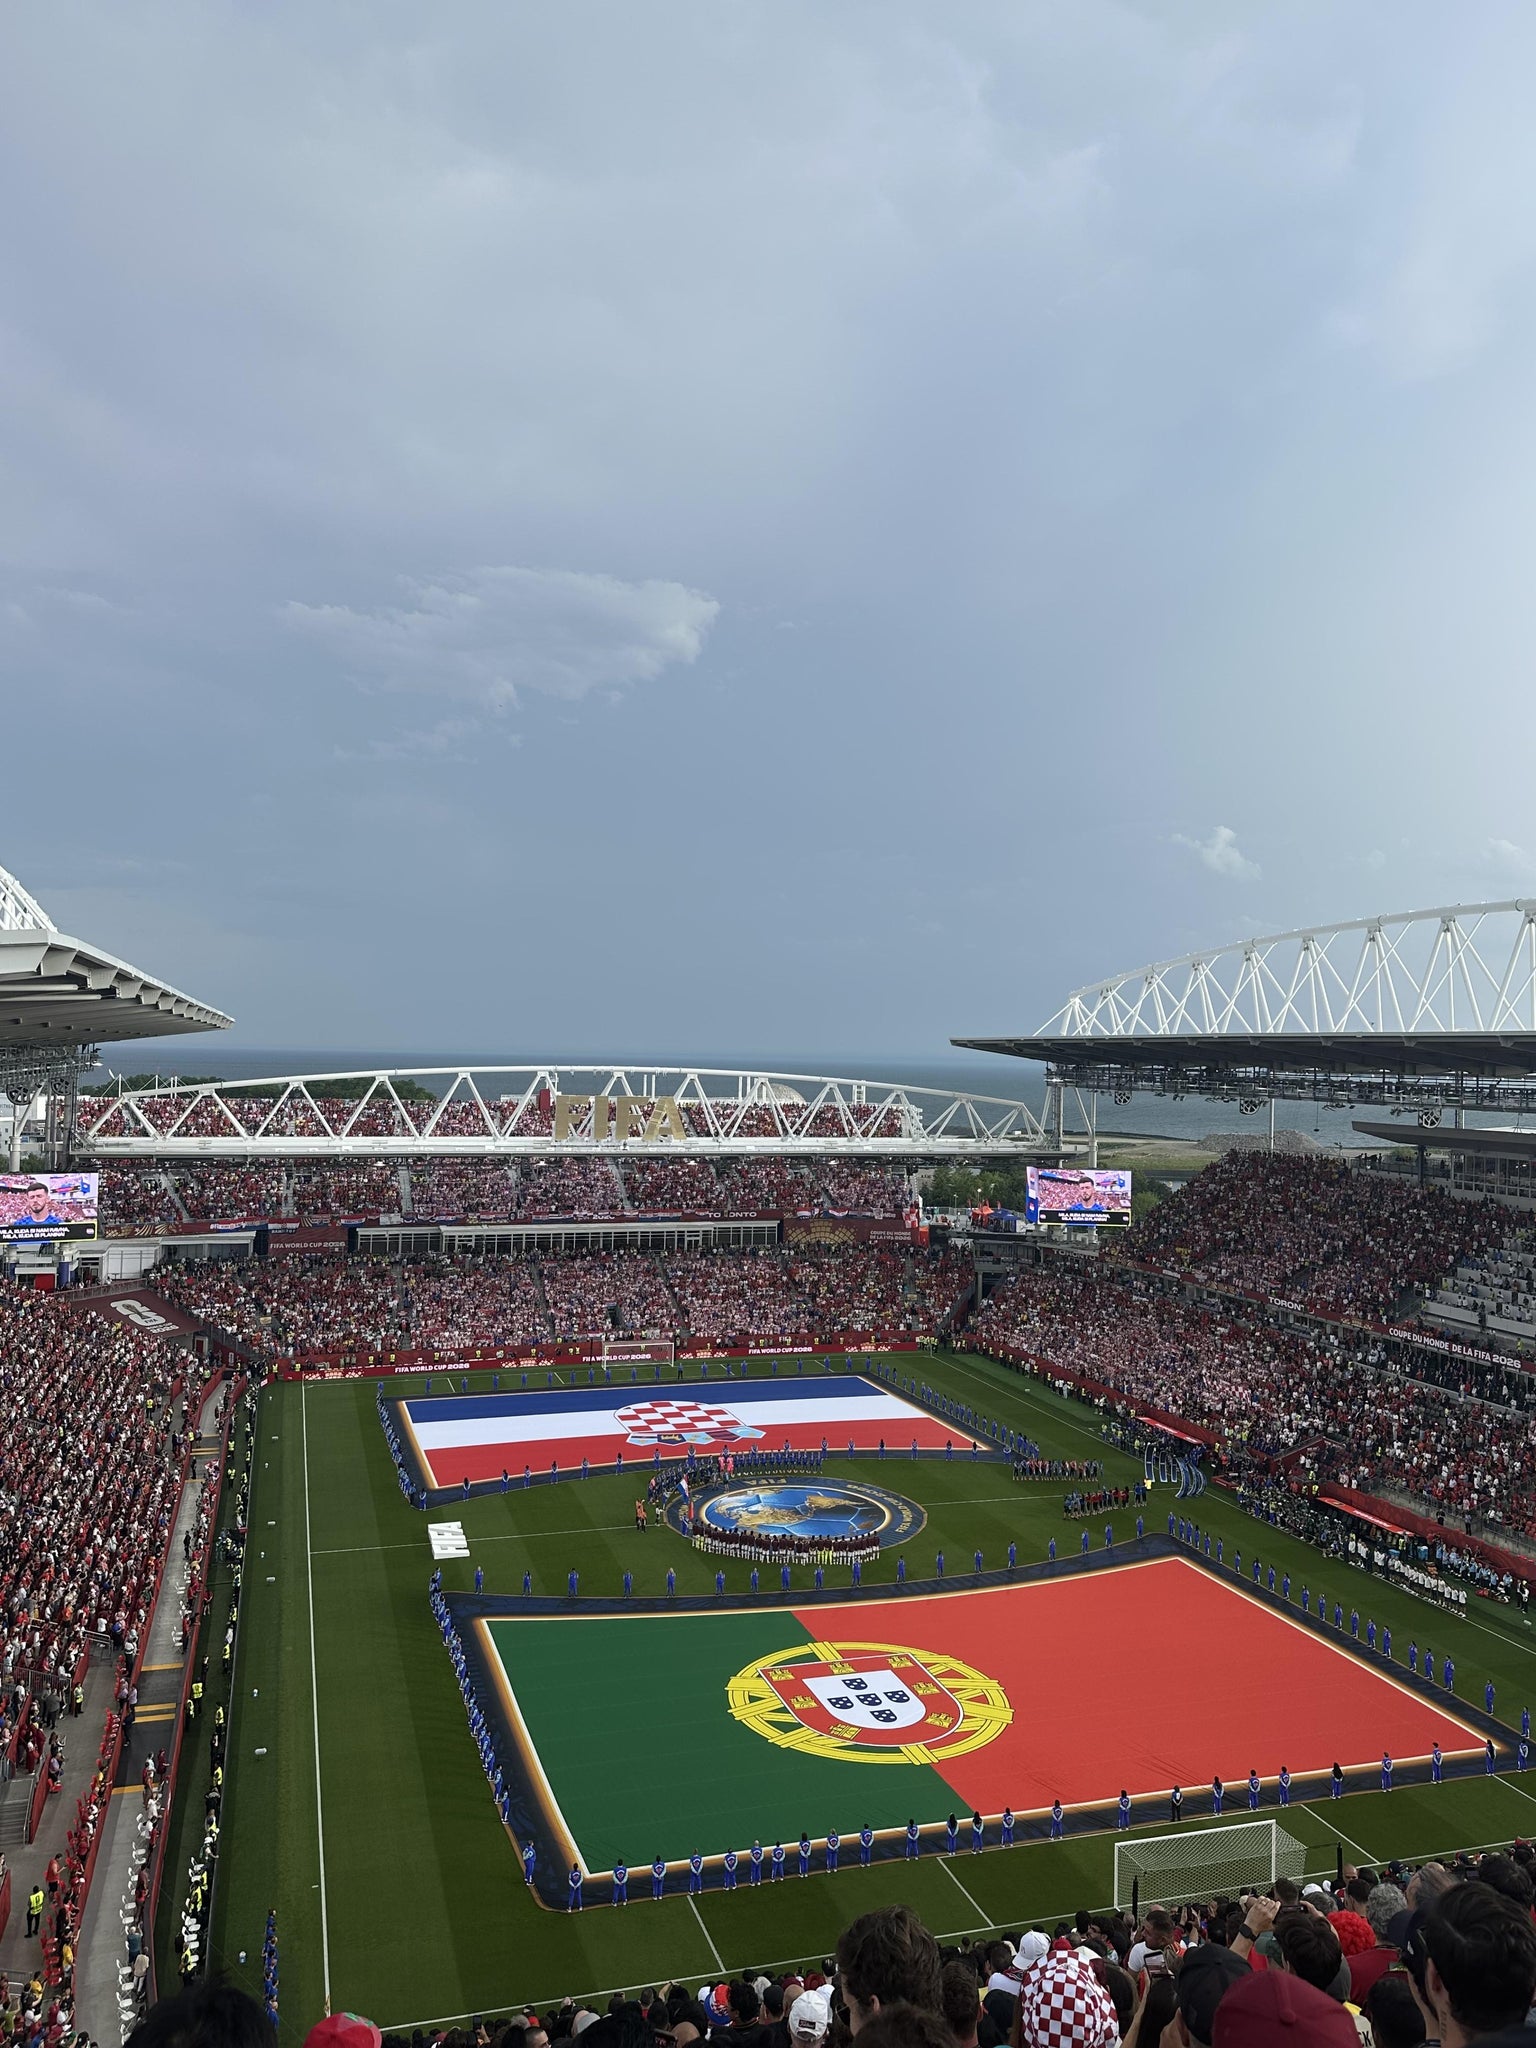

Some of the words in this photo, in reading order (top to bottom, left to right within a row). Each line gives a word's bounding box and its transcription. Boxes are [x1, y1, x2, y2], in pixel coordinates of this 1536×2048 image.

[555, 1095, 687, 1140] FIFA
[1389, 1327, 1412, 1340] COUPE
[1412, 1333, 1423, 1343] DU
[1423, 1336, 1449, 1350] MONDE
[1451, 1343, 1462, 1353] DE
[1463, 1346, 1473, 1357] LA
[1473, 1349, 1491, 1361] FIFA
[1492, 1354, 1521, 1368] 2026
